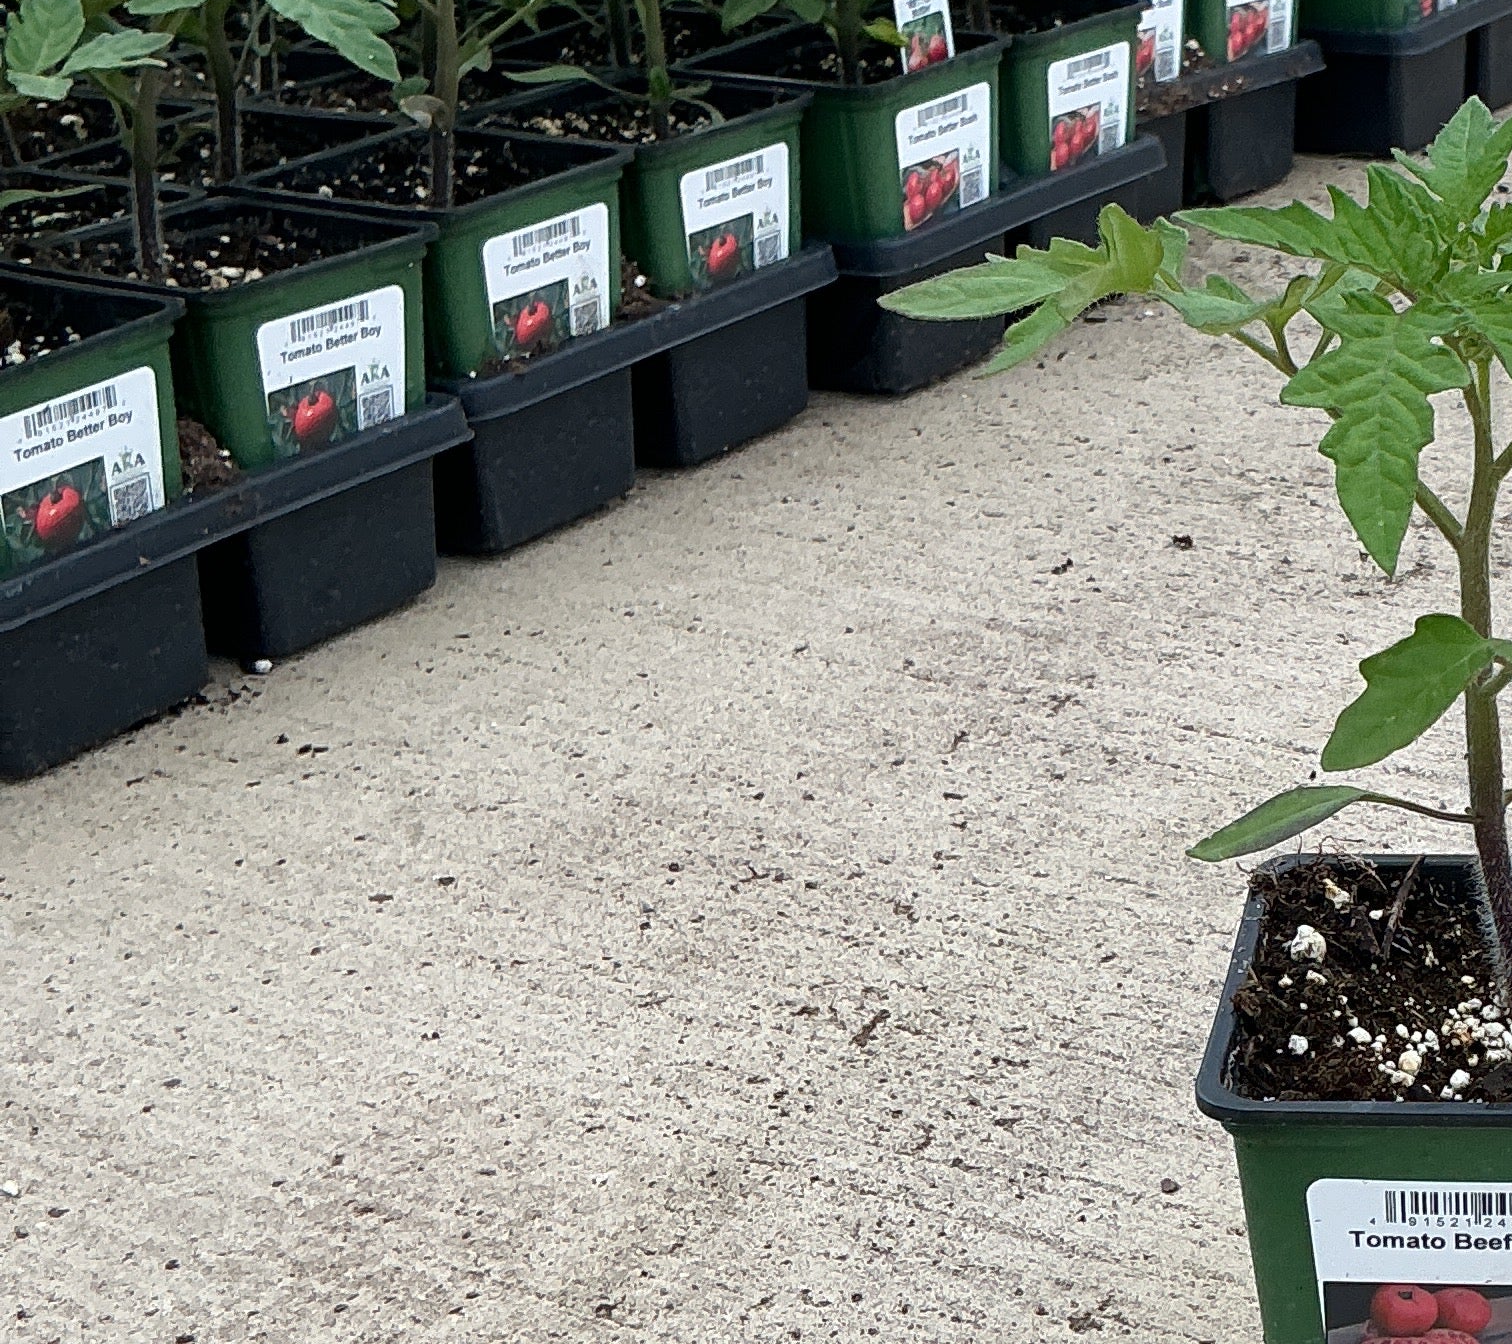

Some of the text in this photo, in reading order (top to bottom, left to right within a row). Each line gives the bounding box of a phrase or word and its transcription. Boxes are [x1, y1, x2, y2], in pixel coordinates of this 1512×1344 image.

[503, 258, 540, 276] Tomato
[542, 247, 570, 264] Better
[573, 240, 591, 253] Boy
[280, 343, 322, 364] Tomato
[325, 332, 358, 350] Better
[361, 326, 381, 338] Boy
[361, 361, 390, 386] AKA
[13, 437, 64, 462] Tomato
[67, 419, 105, 442] Better
[108, 410, 133, 427] Boy
[111, 449, 145, 476] AKA
[1348, 1230, 1446, 1249] Tomato
